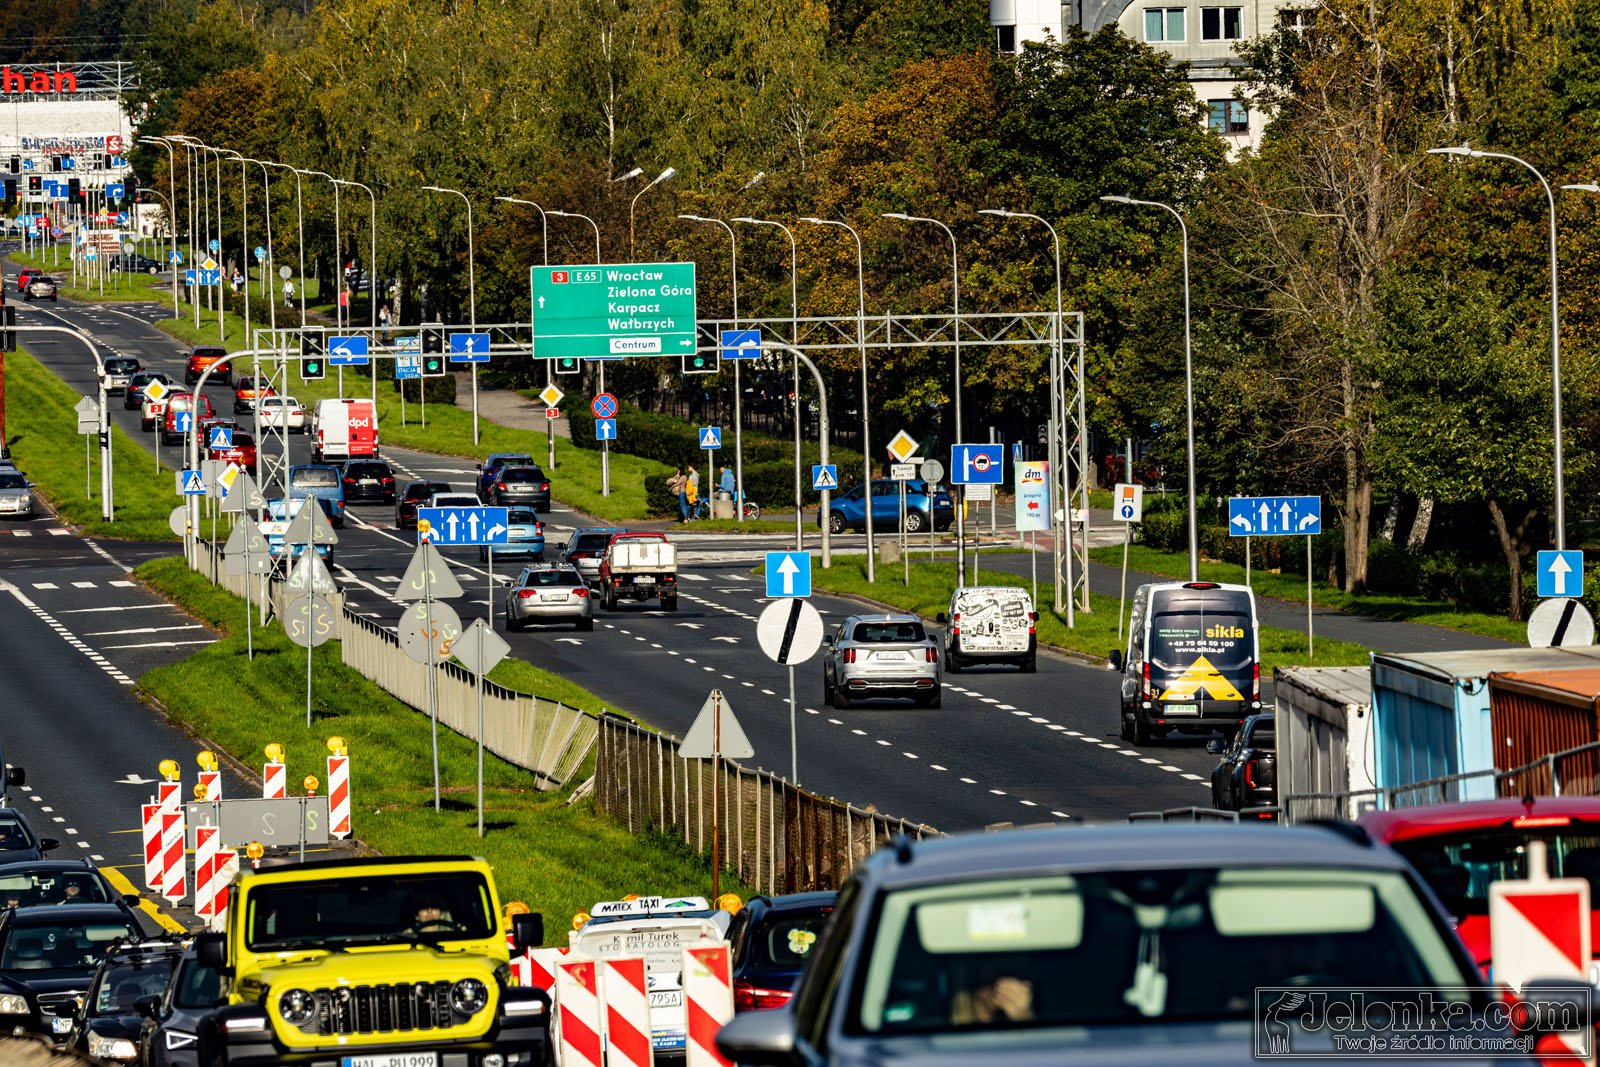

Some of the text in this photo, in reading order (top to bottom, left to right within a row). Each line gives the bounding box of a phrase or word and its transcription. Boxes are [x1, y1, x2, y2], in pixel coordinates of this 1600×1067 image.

[2, 65, 77, 93] han
[556, 269, 663, 282] 3 E 65 Wrocław
[607, 284, 692, 298] Zielona Góra
[608, 302, 660, 315] Karpacz
[608, 317, 675, 332] Wałbrzych
[614, 340, 656, 349] Centrum
[349, 417, 369, 432] dpd
[1024, 469, 1041, 479] dm
[1205, 623, 1244, 638] sikla
[1150, 688, 1160, 696] 31
[601, 898, 660, 912] MATEX TAXI
[613, 932, 679, 944] Kmil Turek
[650, 993, 677, 1005] 795A
